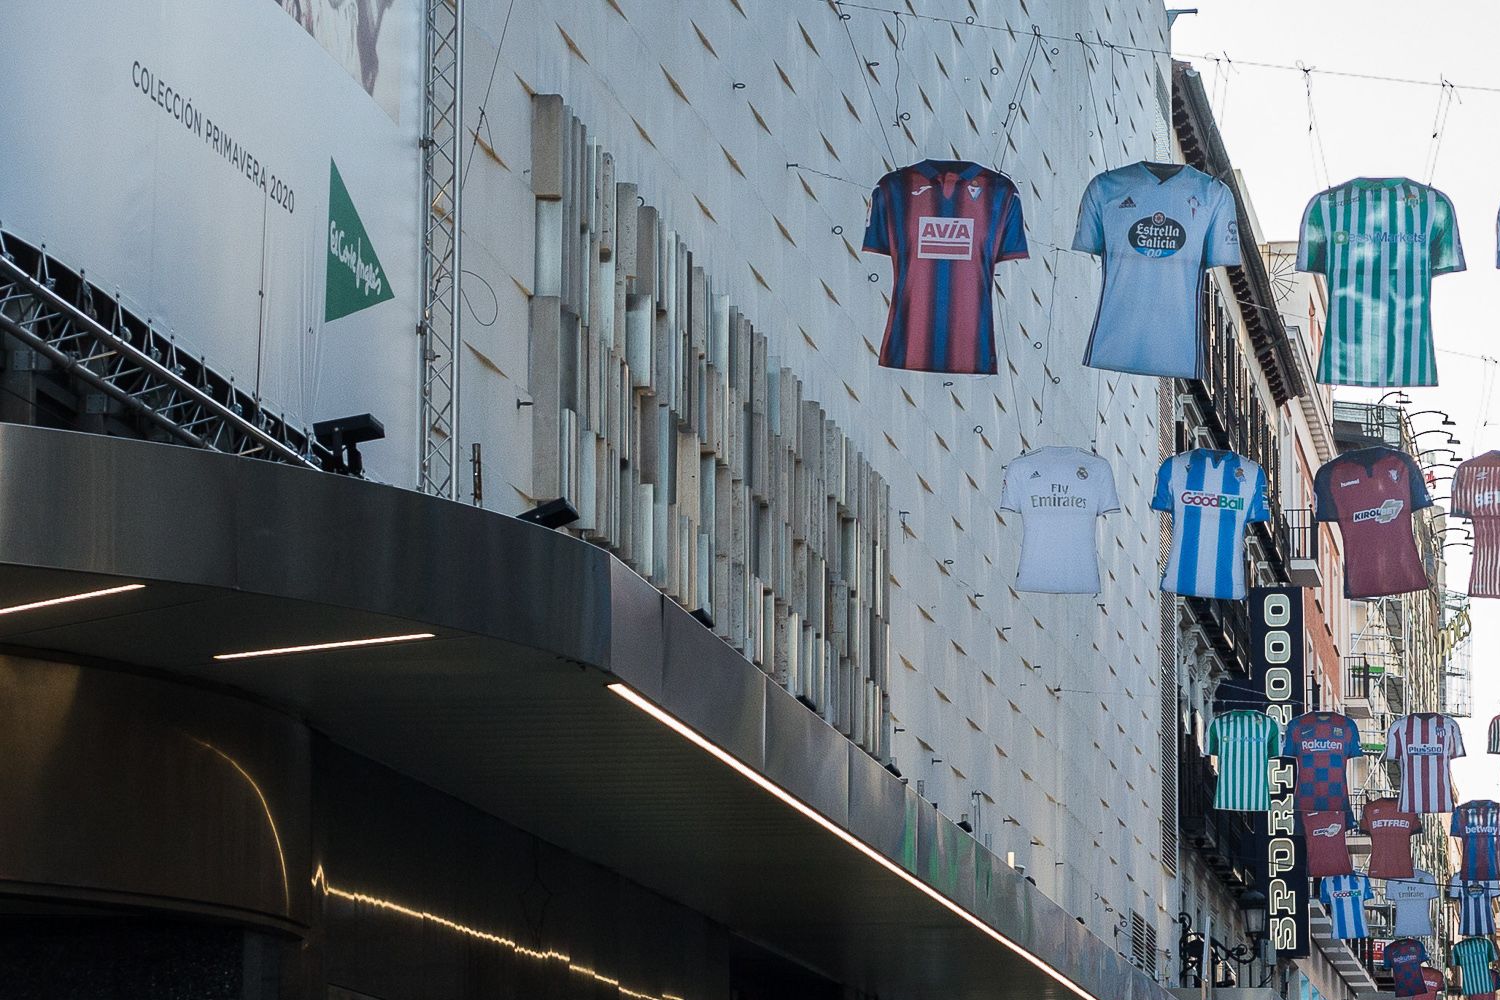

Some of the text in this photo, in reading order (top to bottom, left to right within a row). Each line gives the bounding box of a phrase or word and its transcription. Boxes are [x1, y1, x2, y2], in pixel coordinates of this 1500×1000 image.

[131, 60, 295, 214] COLECCIÓN PRIMAVERA 2020
[1135, 222, 1180, 238] Estrella
[1136, 235, 1177, 251] Galicia
[1051, 483, 1069, 494] Fly
[1030, 493, 1087, 509] Emirates
[1181, 491, 1245, 511] GoodBall
[1301, 738, 1343, 750] Rakuten
[1372, 819, 1409, 829] BETFRED
[1465, 825, 1498, 836] betway
[1267, 758, 1297, 950] SPORT
